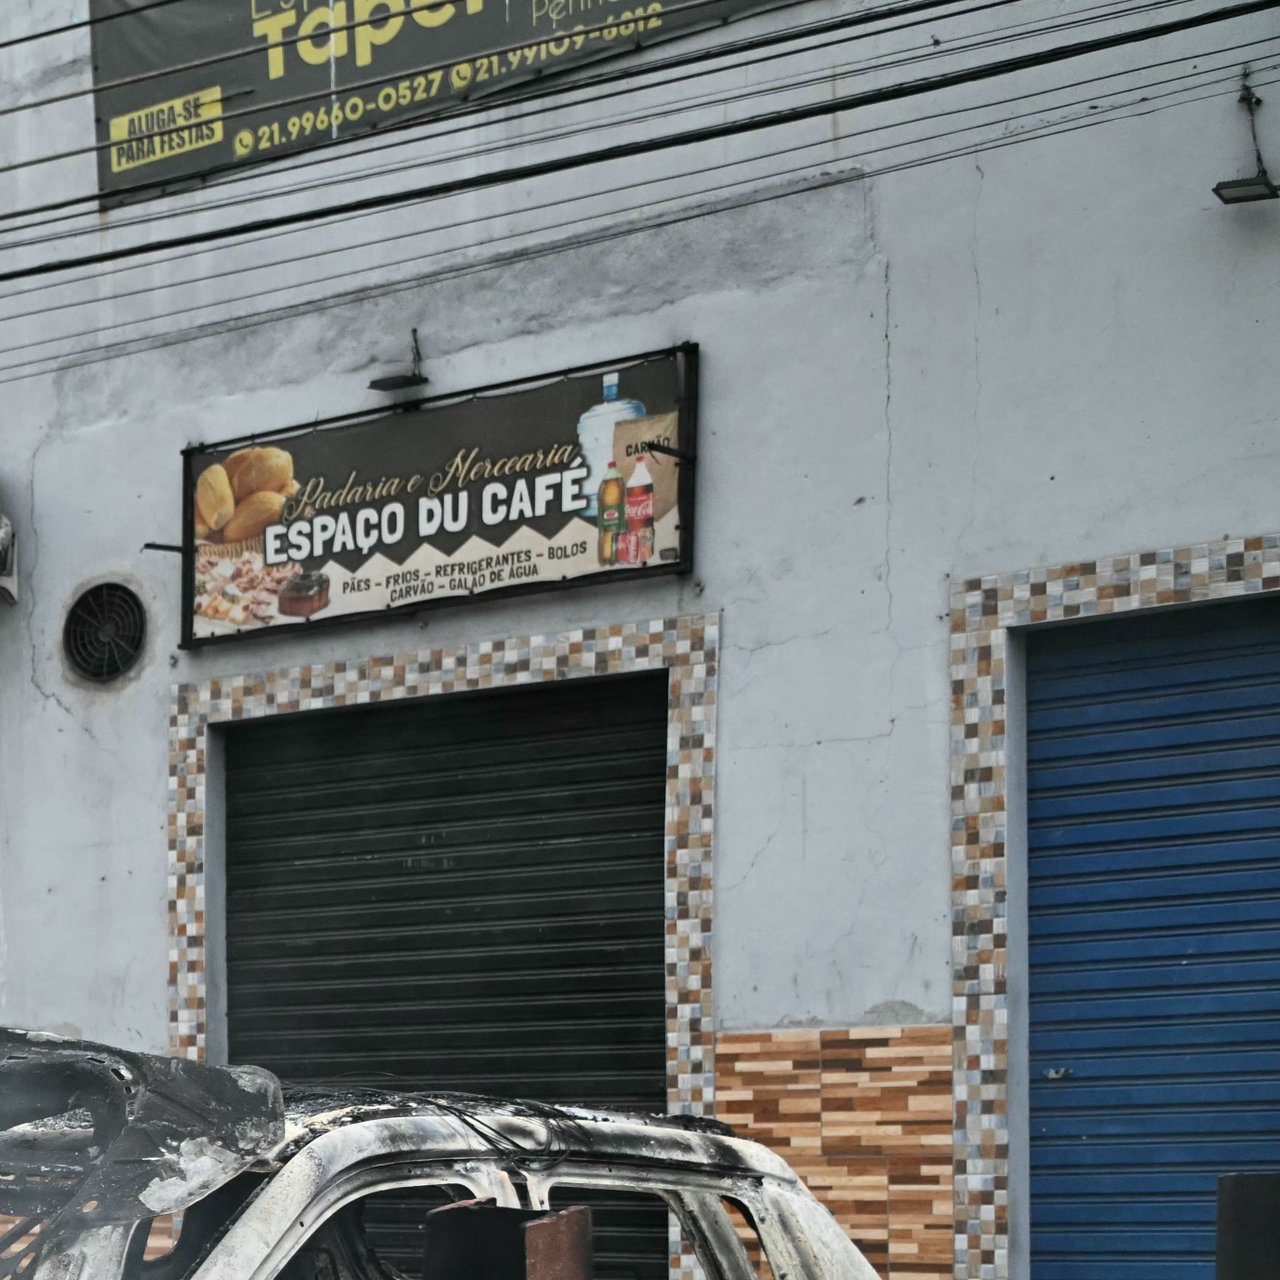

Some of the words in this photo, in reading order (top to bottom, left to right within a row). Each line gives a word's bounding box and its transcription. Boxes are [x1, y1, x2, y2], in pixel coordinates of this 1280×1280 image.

[127, 96, 203, 138] ALUGA-SE
[257, 70, 444, 150] 21.99660-0527
[116, 138, 157, 167] PARA
[160, 122, 216, 154] FESTAS
[283, 470, 407, 524] Padaria
[407, 473, 424, 493] e
[426, 443, 580, 497] Mercearia
[264, 502, 406, 566] ESPAÇO
[417, 490, 469, 537] DU
[481, 456, 589, 525] CAFÉ
[342, 576, 371, 594] PÃES
[385, 569, 420, 588] FRIOS
[435, 549, 532, 578] REFRIGERANTES
[547, 541, 588, 560] BOLOS
[390, 579, 434, 602] CARVÃO
[490, 567, 505, 583] DE
[509, 564, 539, 579] ÁGUA
